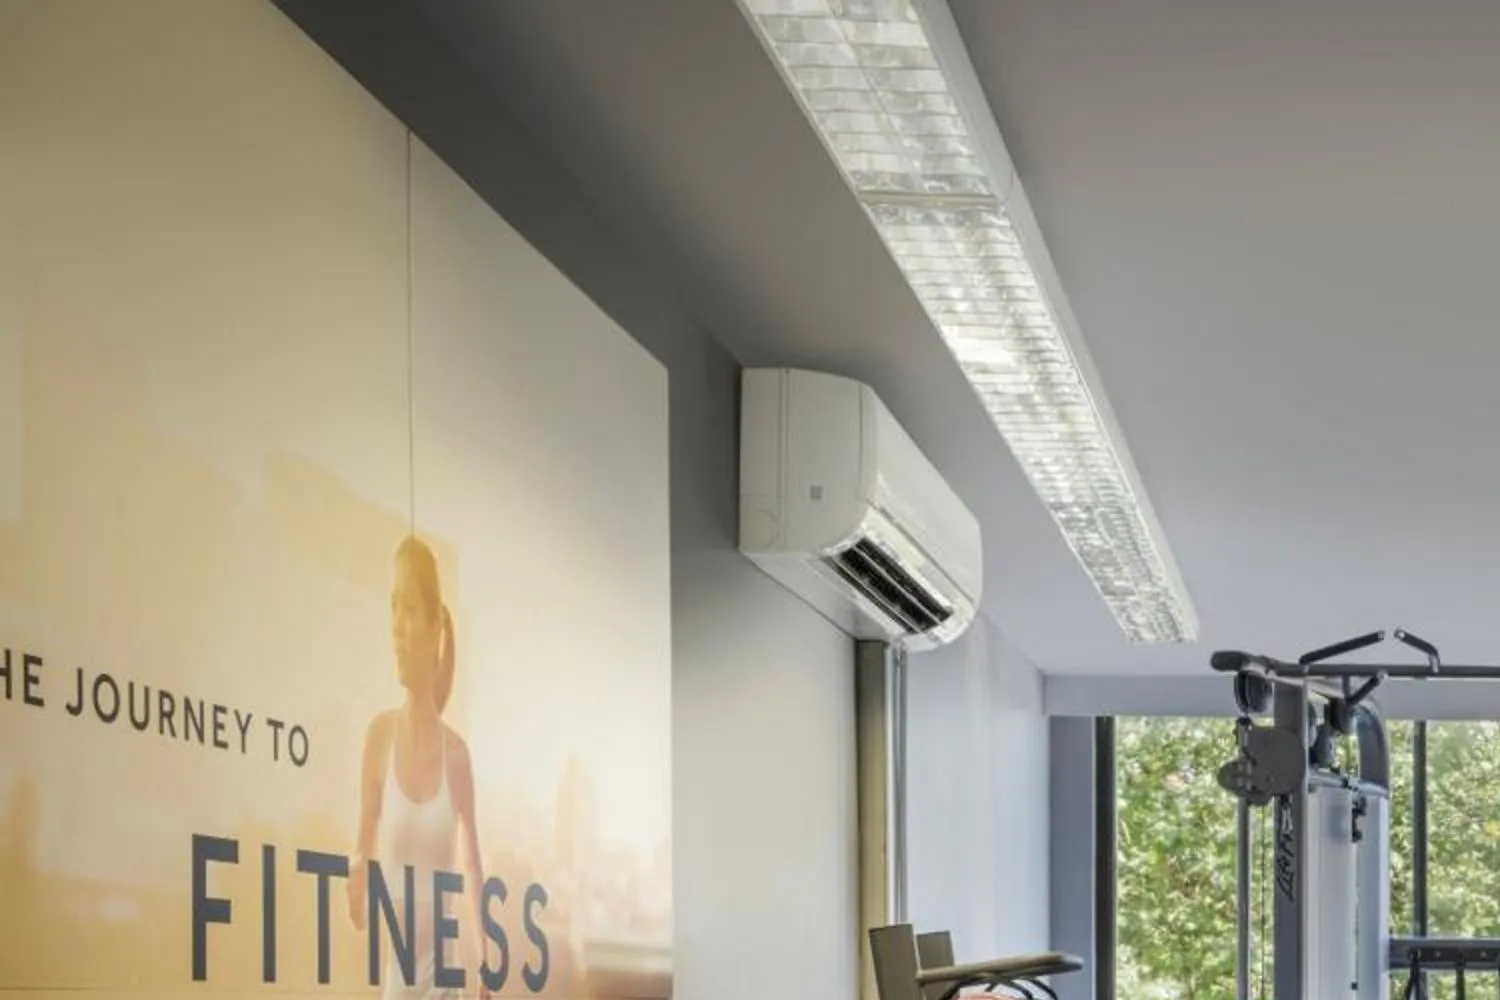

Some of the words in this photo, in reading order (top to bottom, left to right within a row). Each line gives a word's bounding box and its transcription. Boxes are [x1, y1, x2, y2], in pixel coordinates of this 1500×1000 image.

[0, 648, 45, 708] HE
[65, 667, 253, 754] JOURNEY
[266, 717, 309, 767] TO
[191, 833, 550, 993] FITNESS
